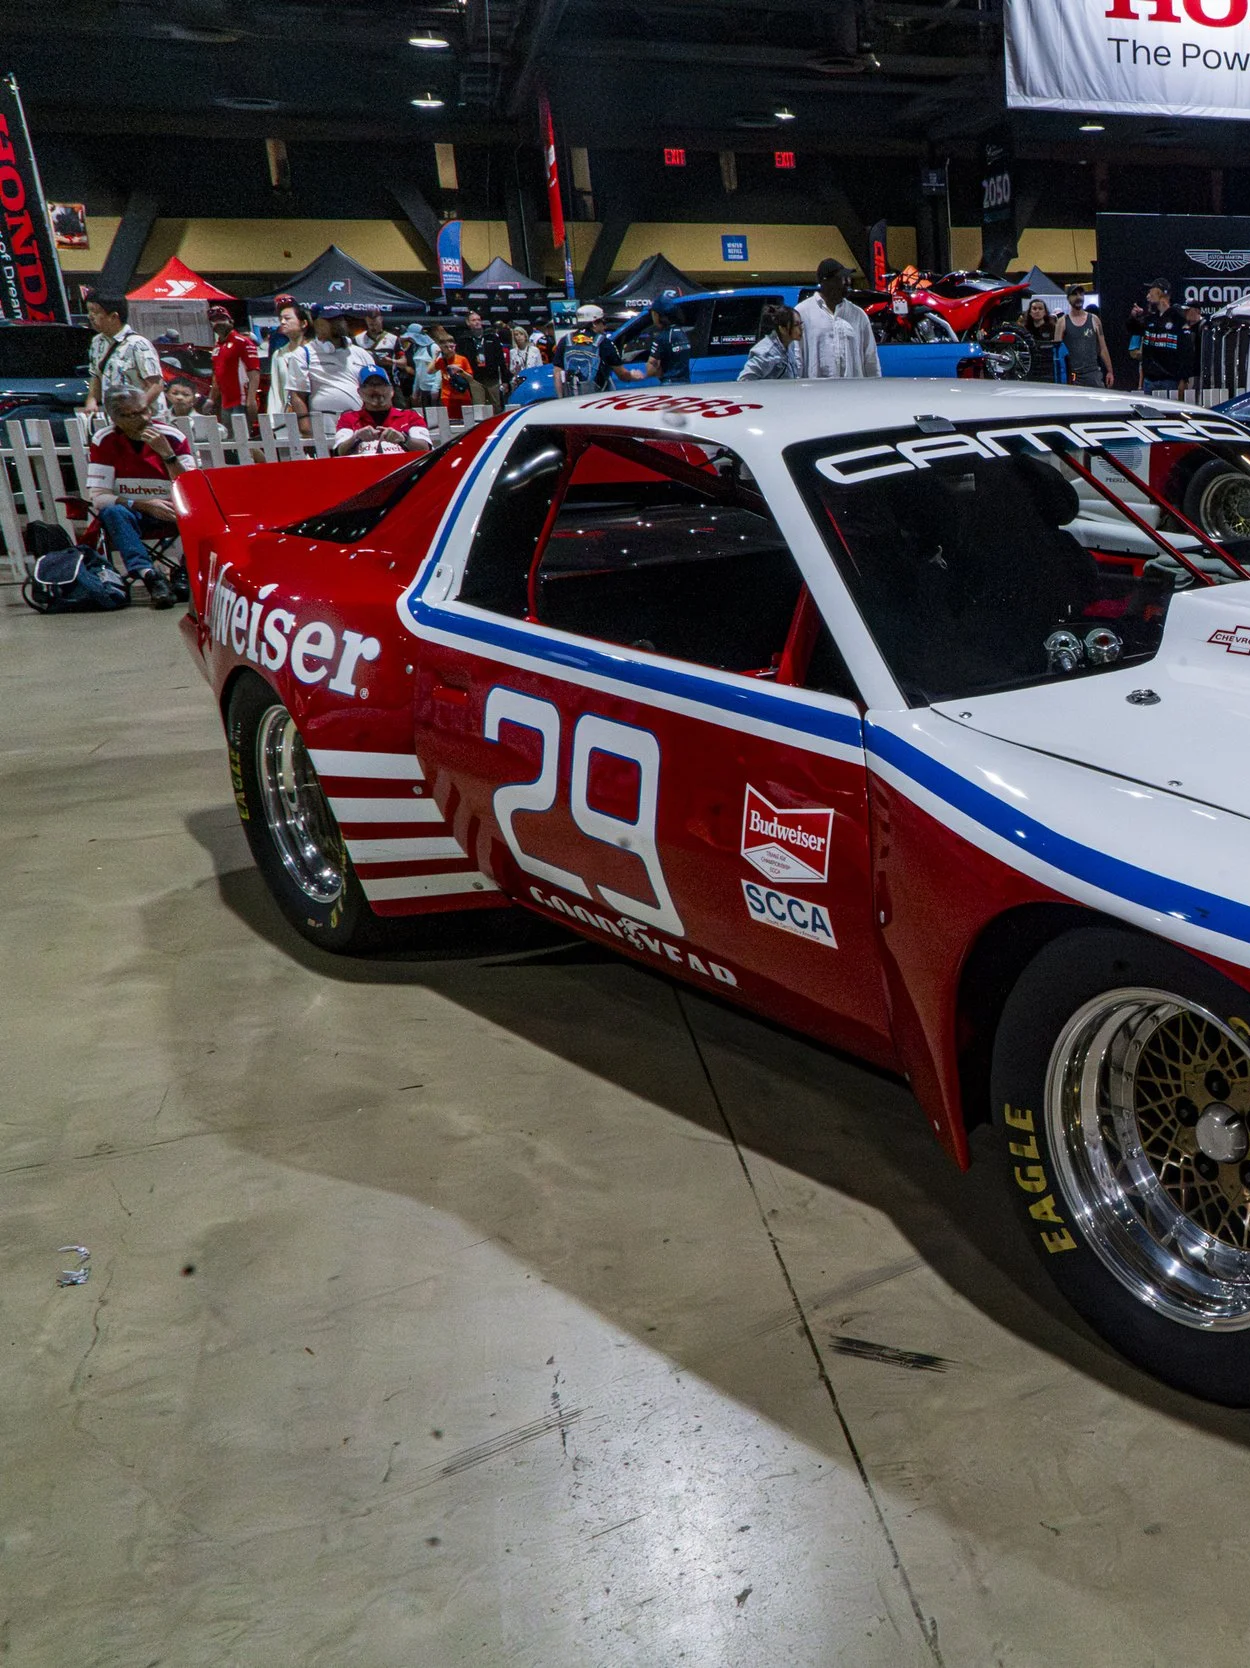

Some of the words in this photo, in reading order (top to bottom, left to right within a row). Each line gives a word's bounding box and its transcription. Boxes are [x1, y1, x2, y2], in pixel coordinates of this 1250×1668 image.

[1106, 37, 1171, 66] The
[664, 148, 686, 167] EXIT
[774, 151, 796, 168] EXIT
[579, 394, 763, 419] HOBBS
[484, 684, 686, 937] 29
[749, 809, 826, 853] Budweiser
[745, 883, 833, 939] SCCA
[1003, 1102, 1078, 1255] EAGLE
